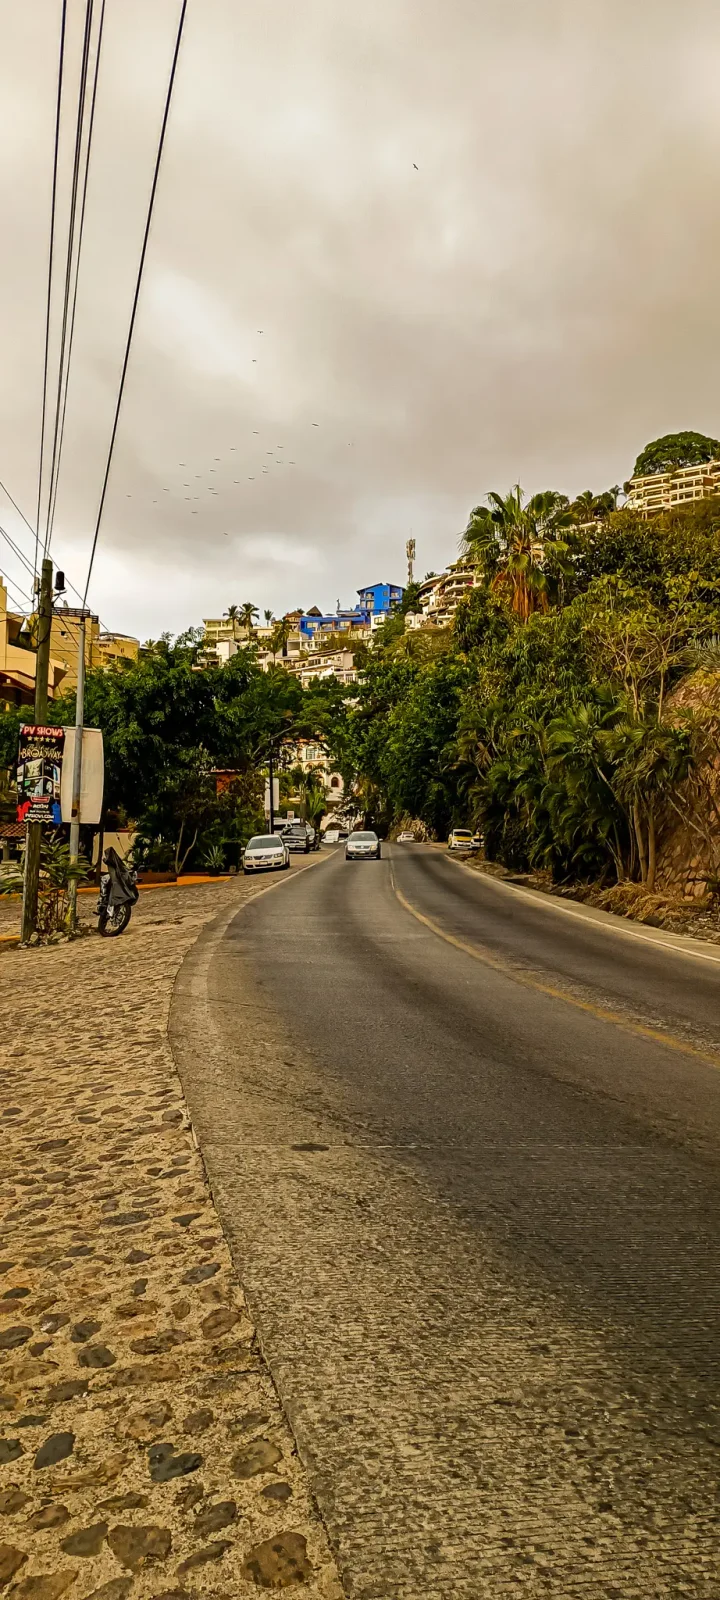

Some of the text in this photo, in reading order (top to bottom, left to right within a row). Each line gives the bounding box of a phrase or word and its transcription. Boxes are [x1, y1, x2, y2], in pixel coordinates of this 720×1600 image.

[24, 726, 63, 737] PV SHOWS
[21, 748, 61, 760] BROADWAY
